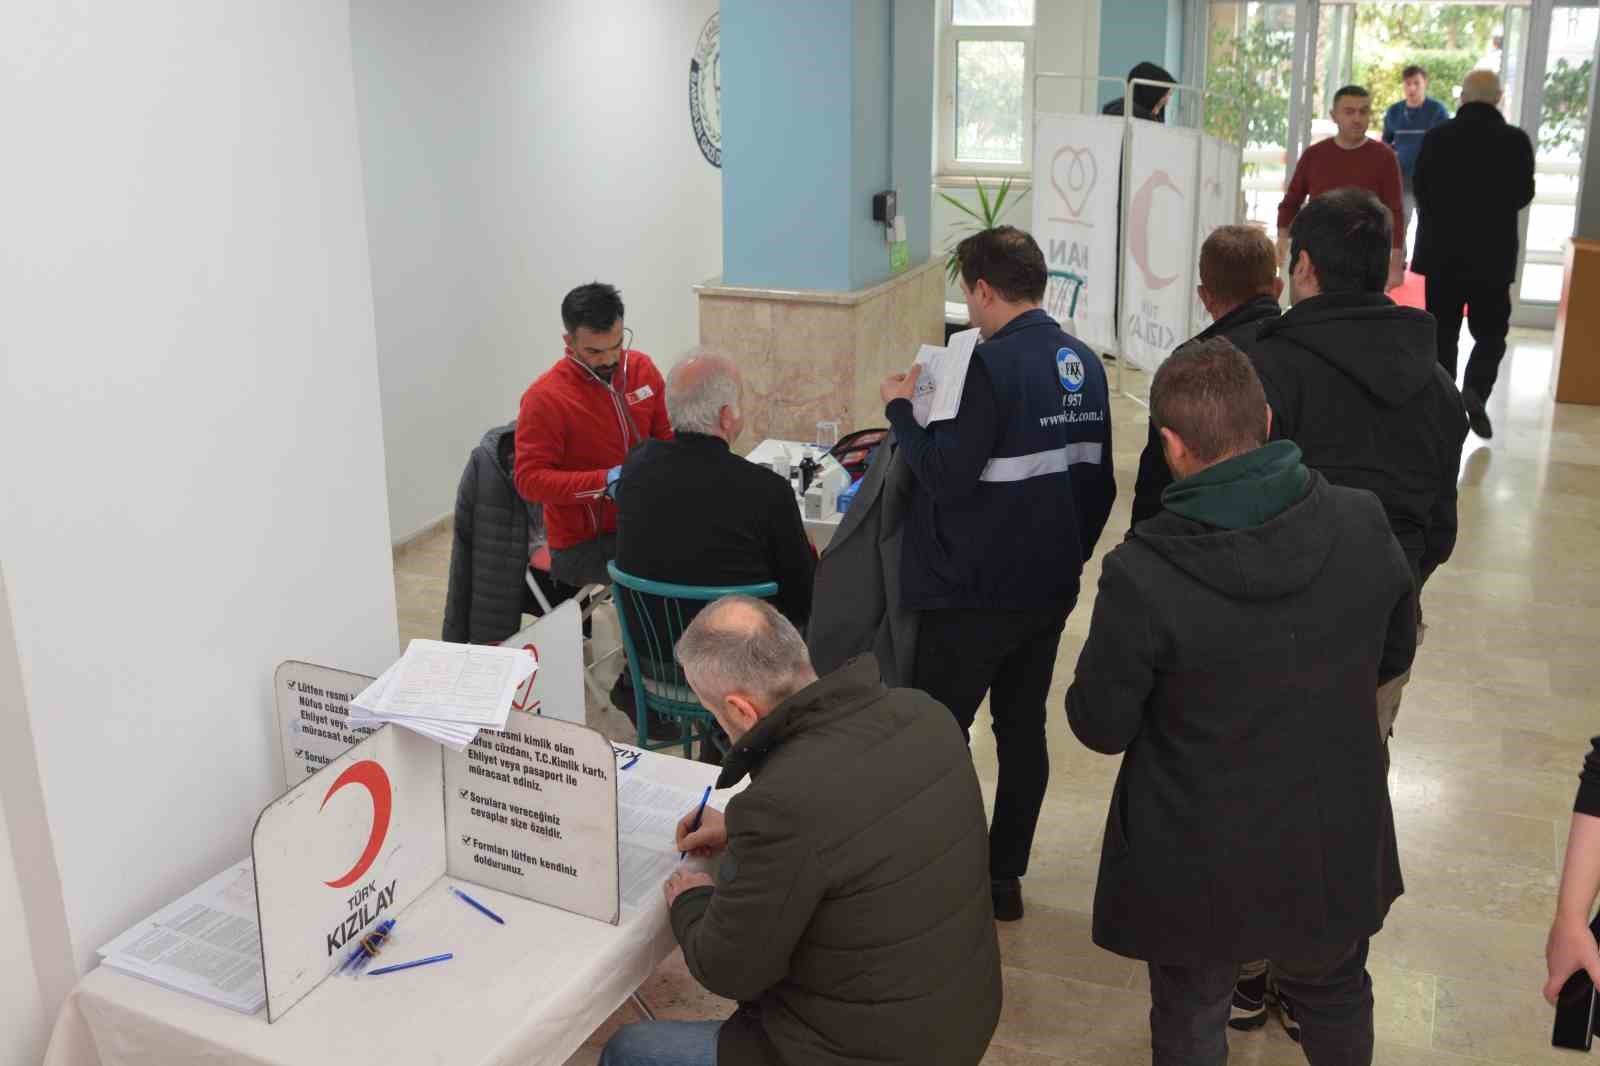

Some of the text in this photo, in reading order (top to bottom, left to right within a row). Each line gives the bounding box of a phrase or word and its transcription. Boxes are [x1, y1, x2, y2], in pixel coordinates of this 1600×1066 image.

[1062, 393, 1083, 407] 1957
[297, 682, 324, 697] Lütfen
[326, 690, 349, 702] resmi
[299, 696, 349, 717] Nüfus cüzda
[300, 710, 328, 725] Ehliyet
[302, 725, 341, 742] müracaat
[496, 730, 522, 743] resmi
[524, 733, 552, 751] kimlik
[554, 742, 575, 756] olan
[467, 749, 578, 786] Ehliyet veya pasaport ile
[470, 736, 607, 781] üfus cüzdanı, T.C.Kimlik kartı,
[468, 764, 543, 792] müracaat ediniz.
[470, 791, 561, 825] Sorulara vereceğiniz
[471, 806, 562, 839] cevaplar size özeldir.
[474, 854, 525, 876] doldurunuz.
[511, 848, 537, 865] lütfen
[539, 857, 578, 877] kendiniz
[347, 879, 377, 911] TÜRK
[326, 879, 397, 957] KIZILAY
